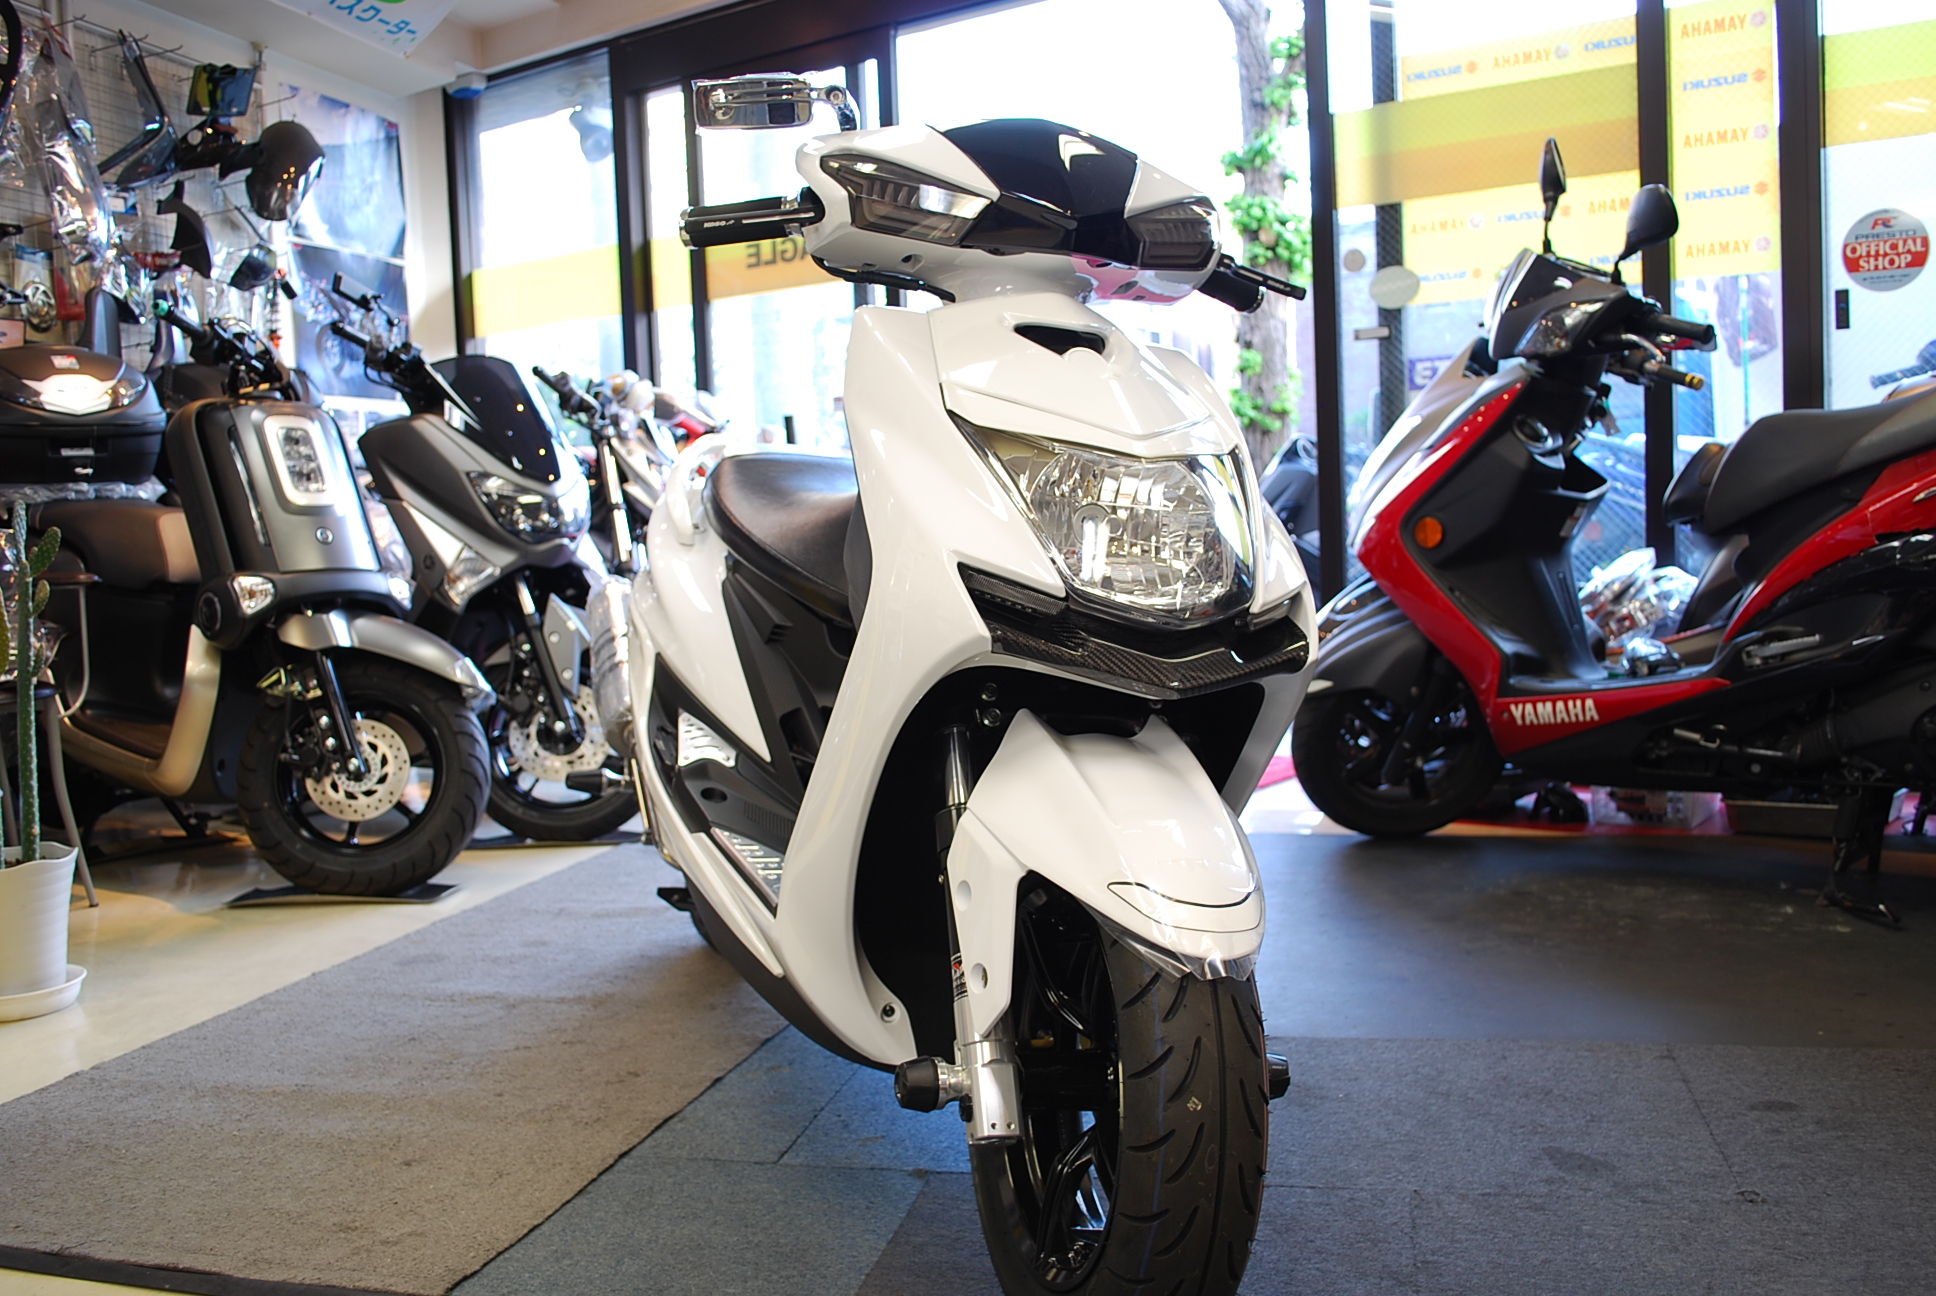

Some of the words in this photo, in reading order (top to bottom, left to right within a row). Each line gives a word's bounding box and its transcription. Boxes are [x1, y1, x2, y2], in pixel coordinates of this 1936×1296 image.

[1845, 236, 1927, 259] OFFICIAL
[1858, 253, 1912, 273] SHOP
[1509, 697, 1600, 727] YAMAHA
